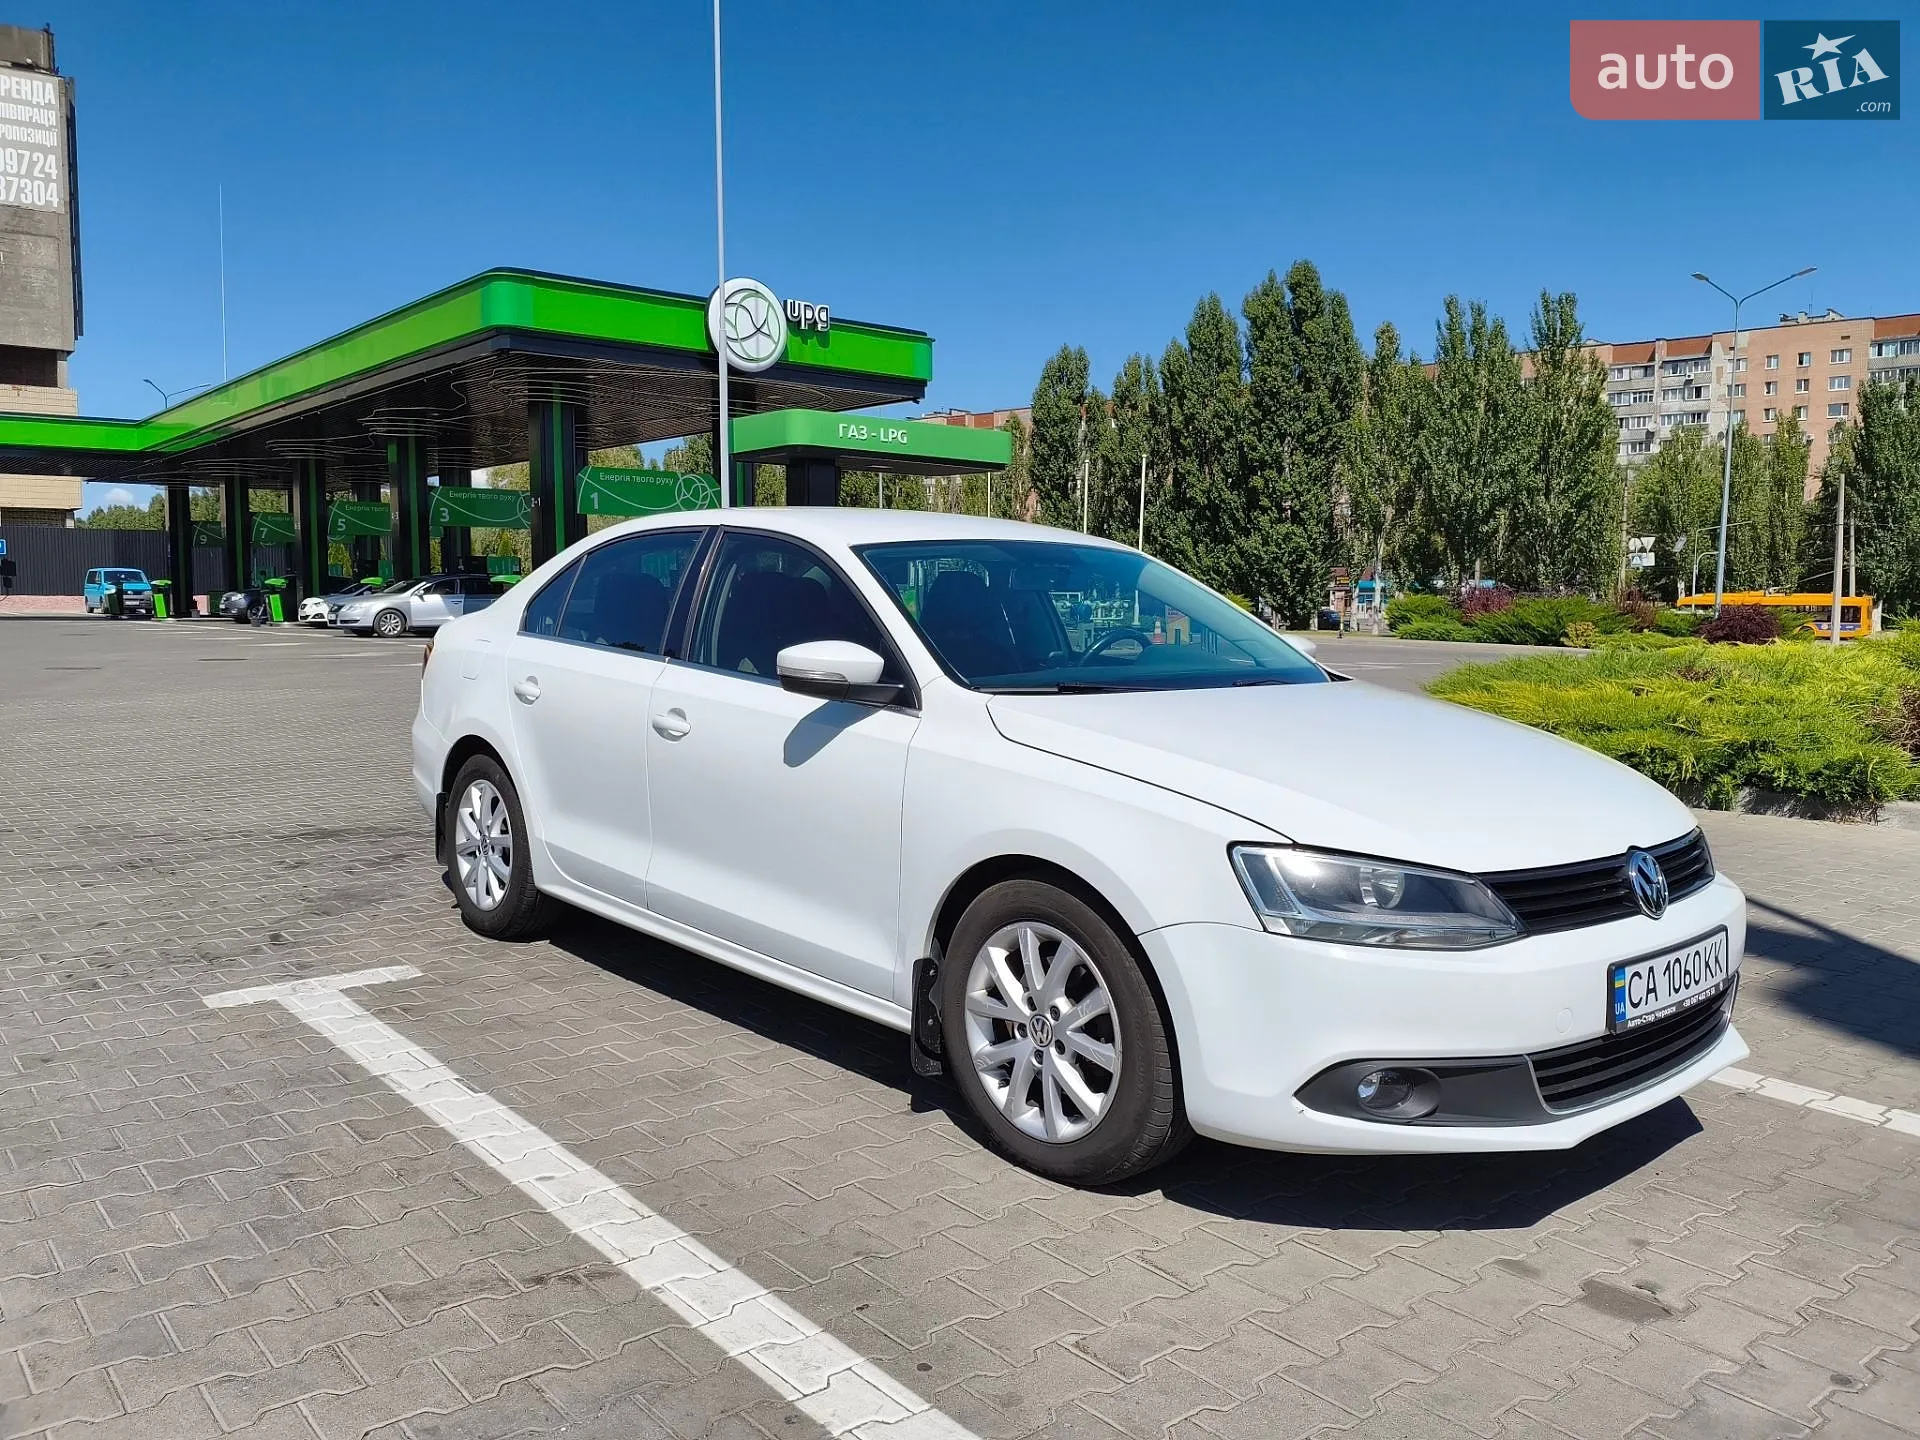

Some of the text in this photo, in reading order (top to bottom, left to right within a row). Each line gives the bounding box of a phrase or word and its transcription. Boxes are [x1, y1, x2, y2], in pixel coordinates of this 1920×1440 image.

[0, 74, 55, 105] РЕНДА
[787, 299, 830, 331] upg
[838, 423, 868, 440] ГАЗ
[880, 427, 908, 444] LPG
[600, 472, 674, 487] Енергія твого руху
[590, 492, 599, 510] 1
[440, 507, 450, 521] 3
[337, 518, 346, 531] 5
[200, 534, 207, 544] 9
[260, 527, 268, 539] 7
[1628, 939, 1723, 1009] CA 1060 KK
[1615, 1001, 1625, 1015] UA
